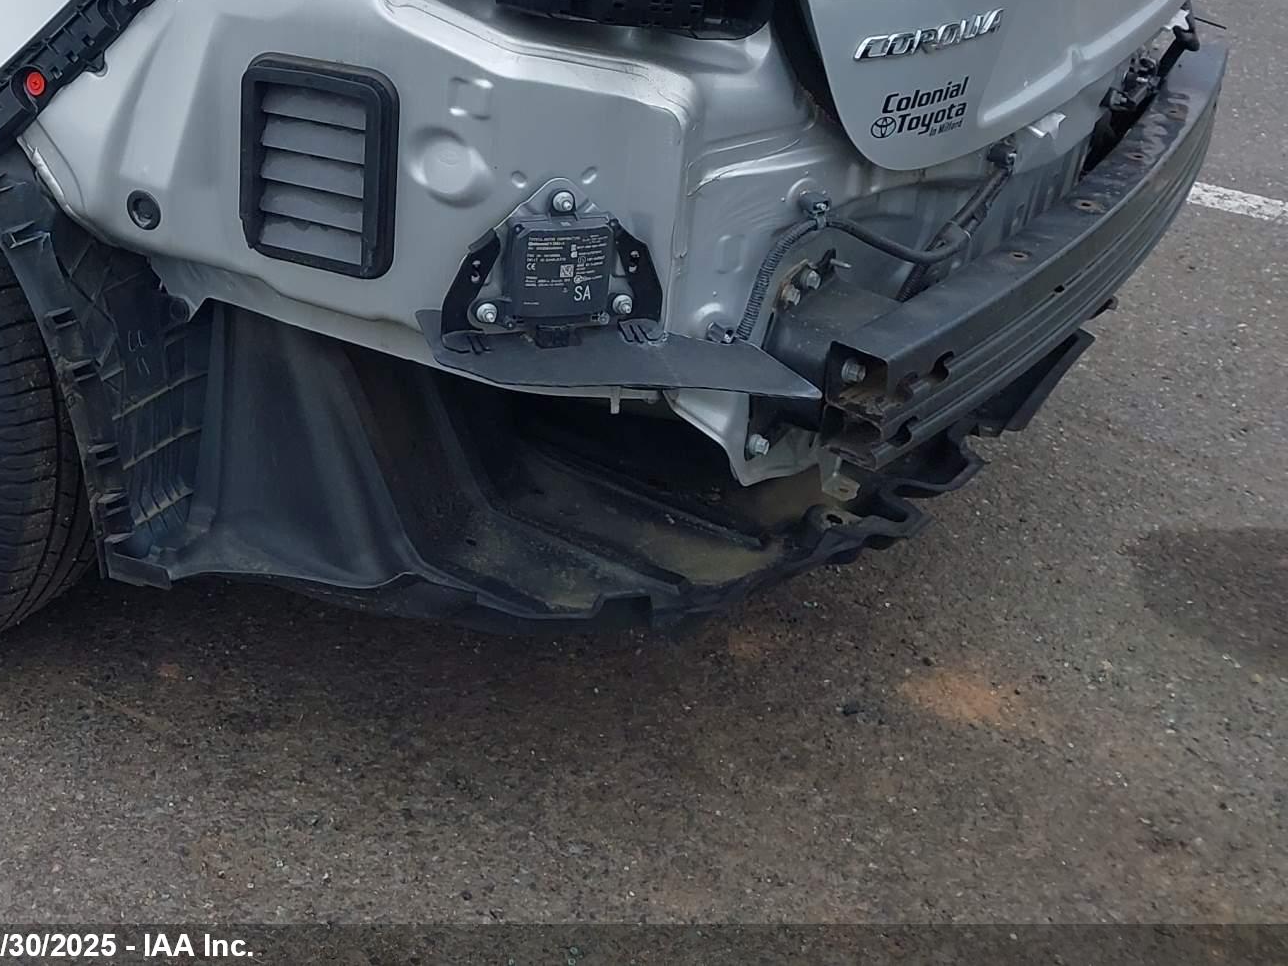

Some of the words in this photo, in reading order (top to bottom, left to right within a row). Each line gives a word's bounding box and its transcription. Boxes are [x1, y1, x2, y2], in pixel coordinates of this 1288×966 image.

[882, 76, 969, 114] Colonial
[898, 102, 967, 135] Toyota
[573, 285, 591, 302] SA
